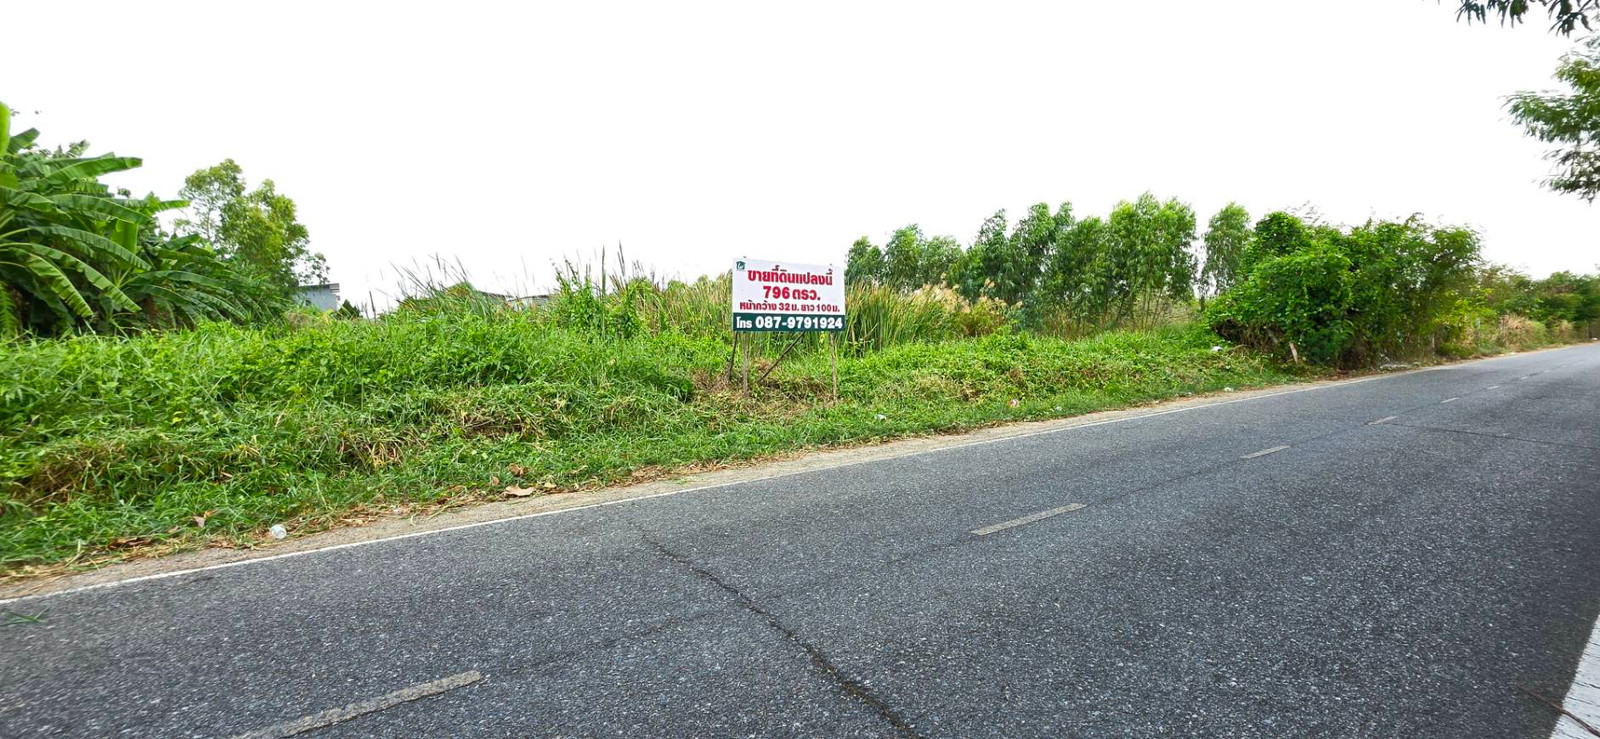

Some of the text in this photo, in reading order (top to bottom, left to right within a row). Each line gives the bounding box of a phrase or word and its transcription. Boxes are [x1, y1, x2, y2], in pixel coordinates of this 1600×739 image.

[763, 286, 790, 299] 796
[739, 299, 777, 311] หน้ากว้าง
[778, 303, 790, 311] 32
[801, 304, 815, 312] ยาว
[736, 316, 843, 329] โทร 087-9791924
